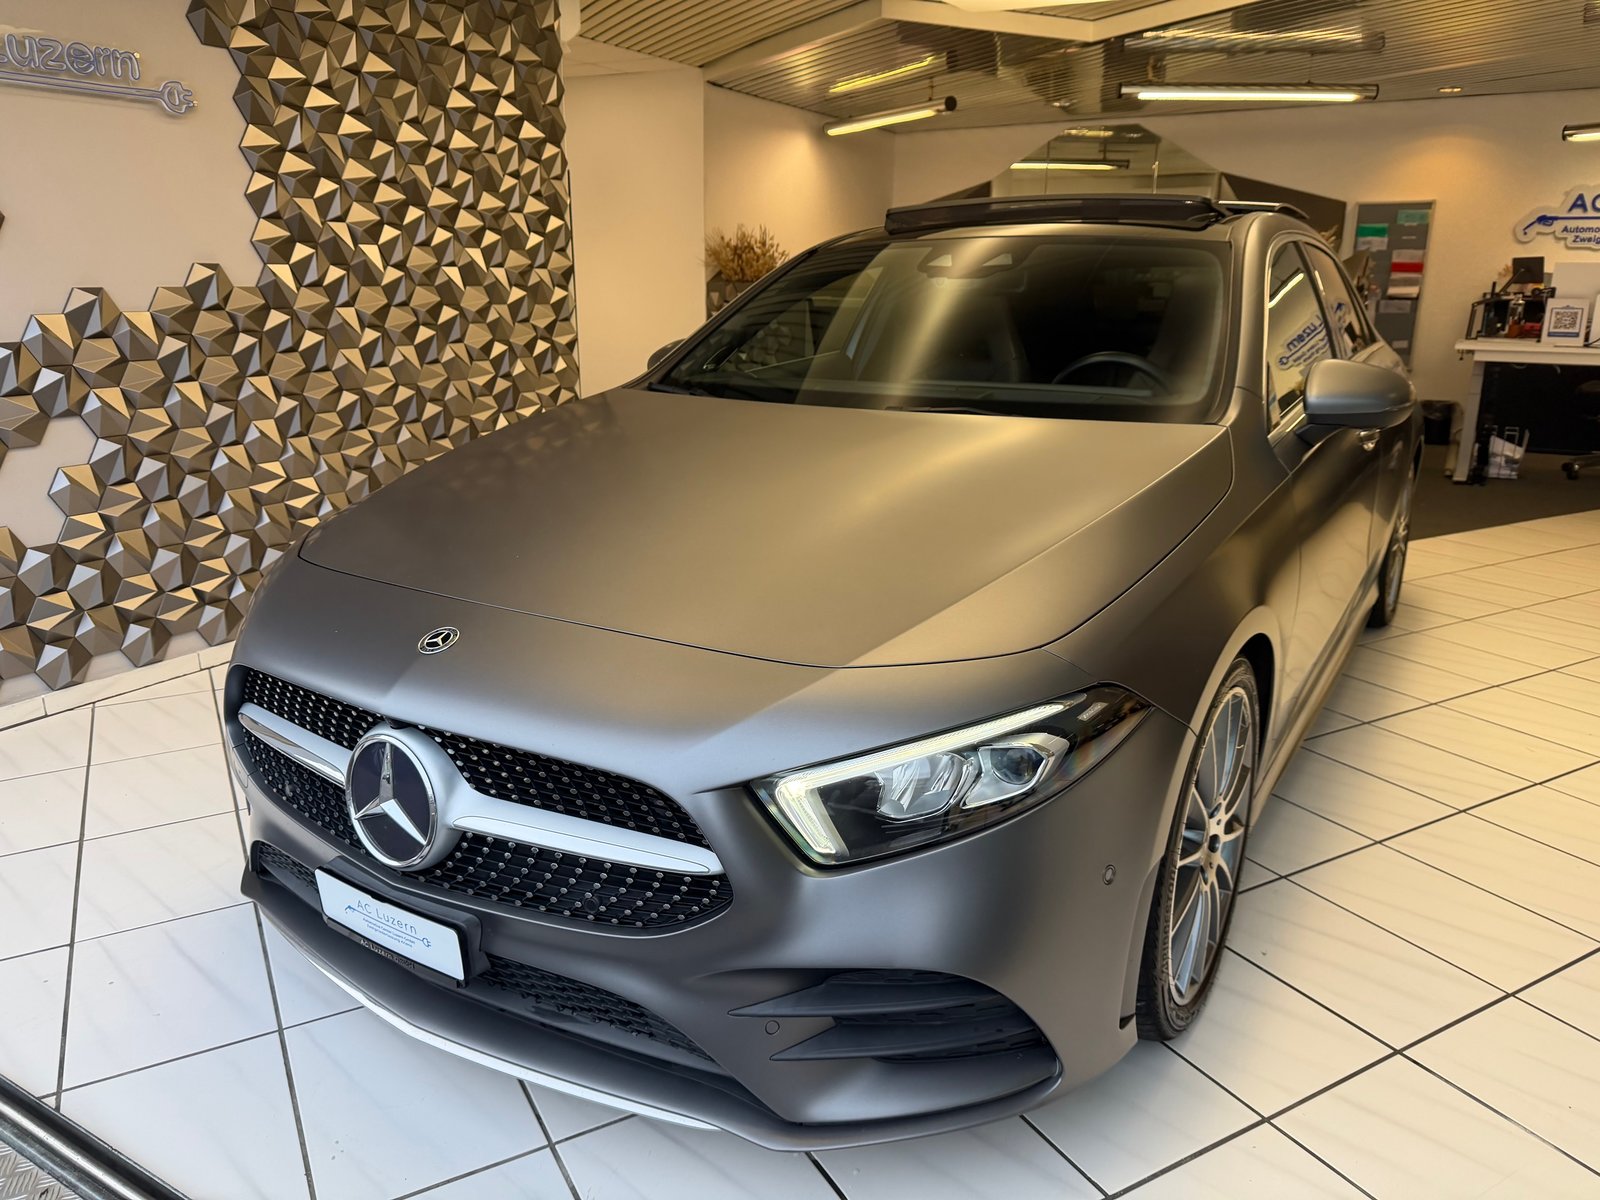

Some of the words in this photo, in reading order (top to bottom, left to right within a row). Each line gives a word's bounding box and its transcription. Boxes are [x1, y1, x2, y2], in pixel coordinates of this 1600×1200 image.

[0, 33, 140, 80] uzern
[357, 899, 372, 914] AC
[376, 907, 417, 934] Luzern
